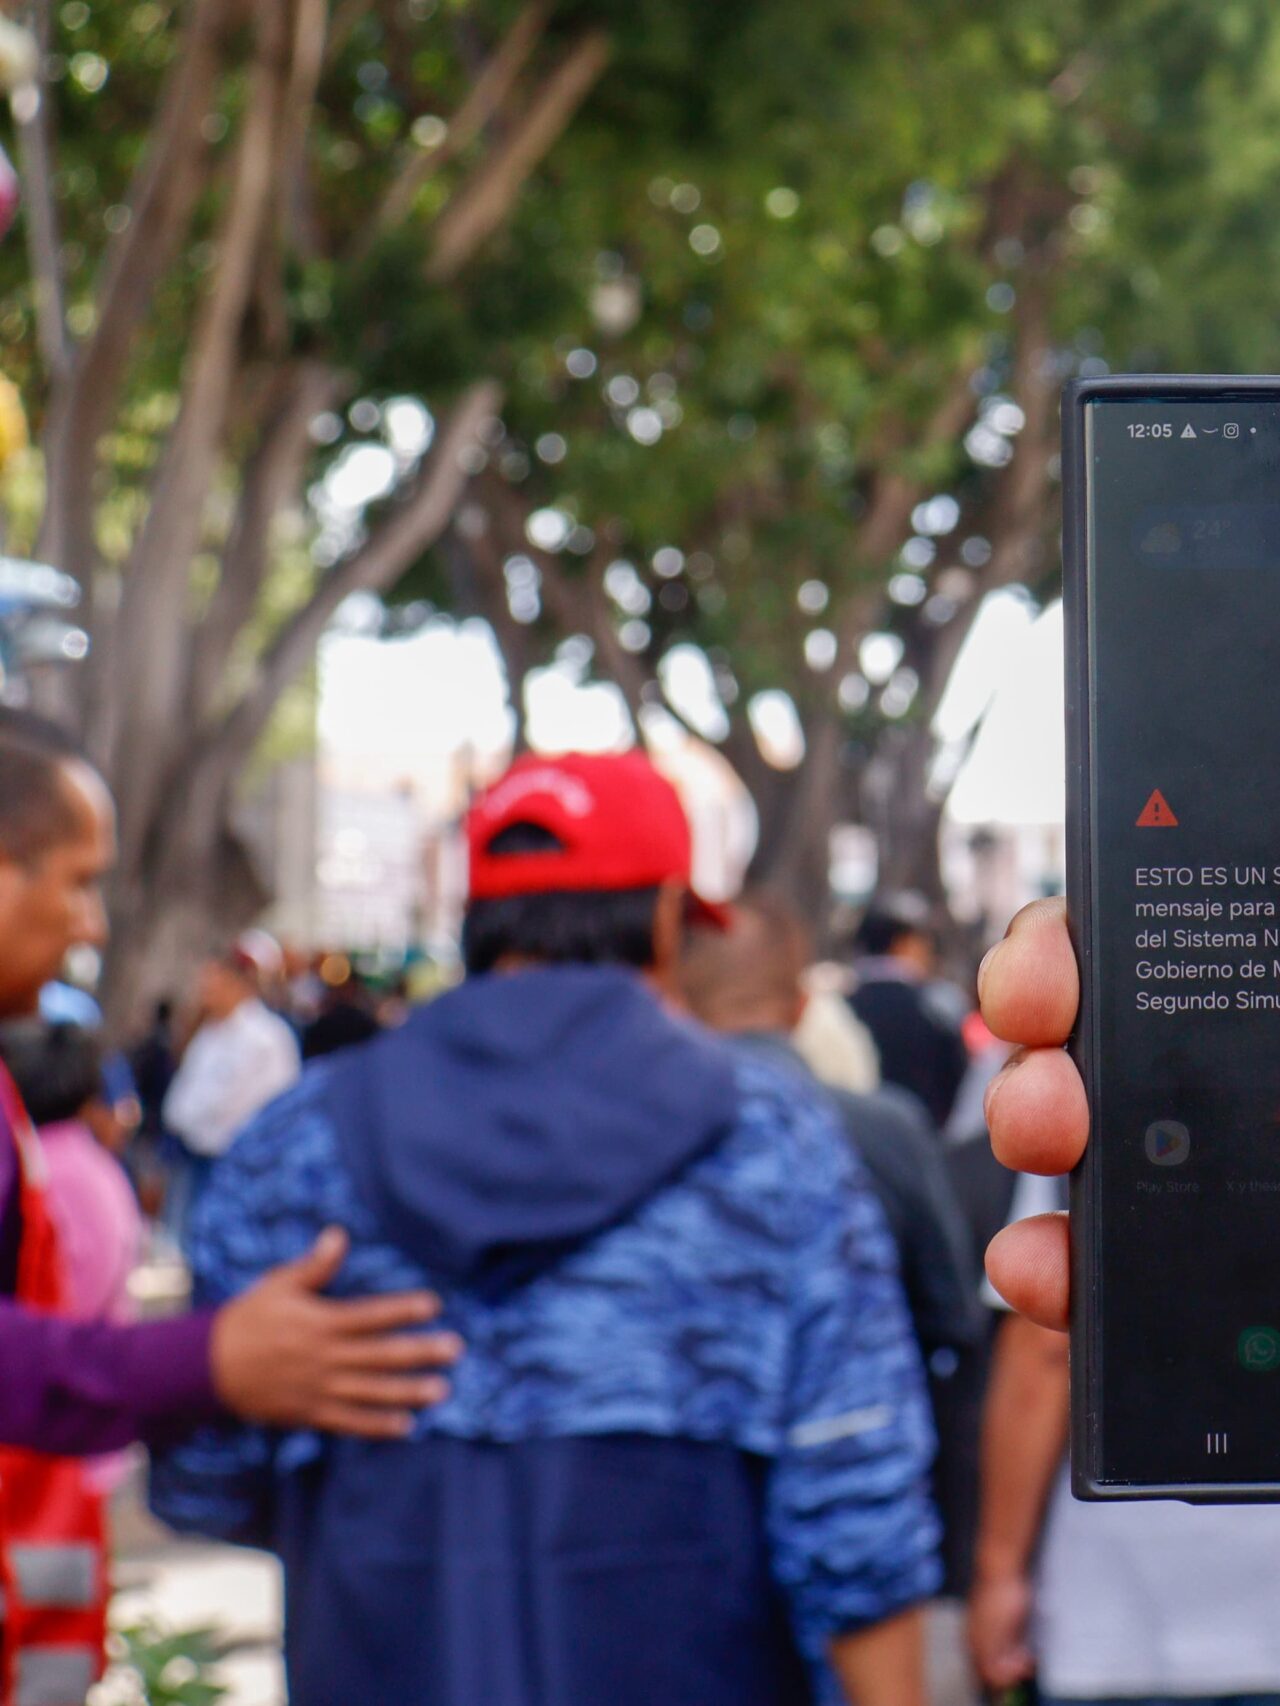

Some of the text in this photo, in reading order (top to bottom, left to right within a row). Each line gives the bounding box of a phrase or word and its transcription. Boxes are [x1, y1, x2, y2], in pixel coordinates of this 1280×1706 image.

[1126, 422, 1173, 439] 12:05
[1135, 867, 1194, 887] ESTO
[1200, 866, 1228, 886] ES
[1234, 866, 1266, 886] UN
[1135, 898, 1223, 922] mensaje
[1229, 901, 1275, 921] para
[1135, 929, 1167, 949] del
[1173, 929, 1257, 948] Sistema
[1135, 960, 1234, 980] Gobierno
[1239, 959, 1266, 979] de
[1135, 990, 1230, 1015] Segundo
[1136, 1180, 1200, 1196] Play Store
